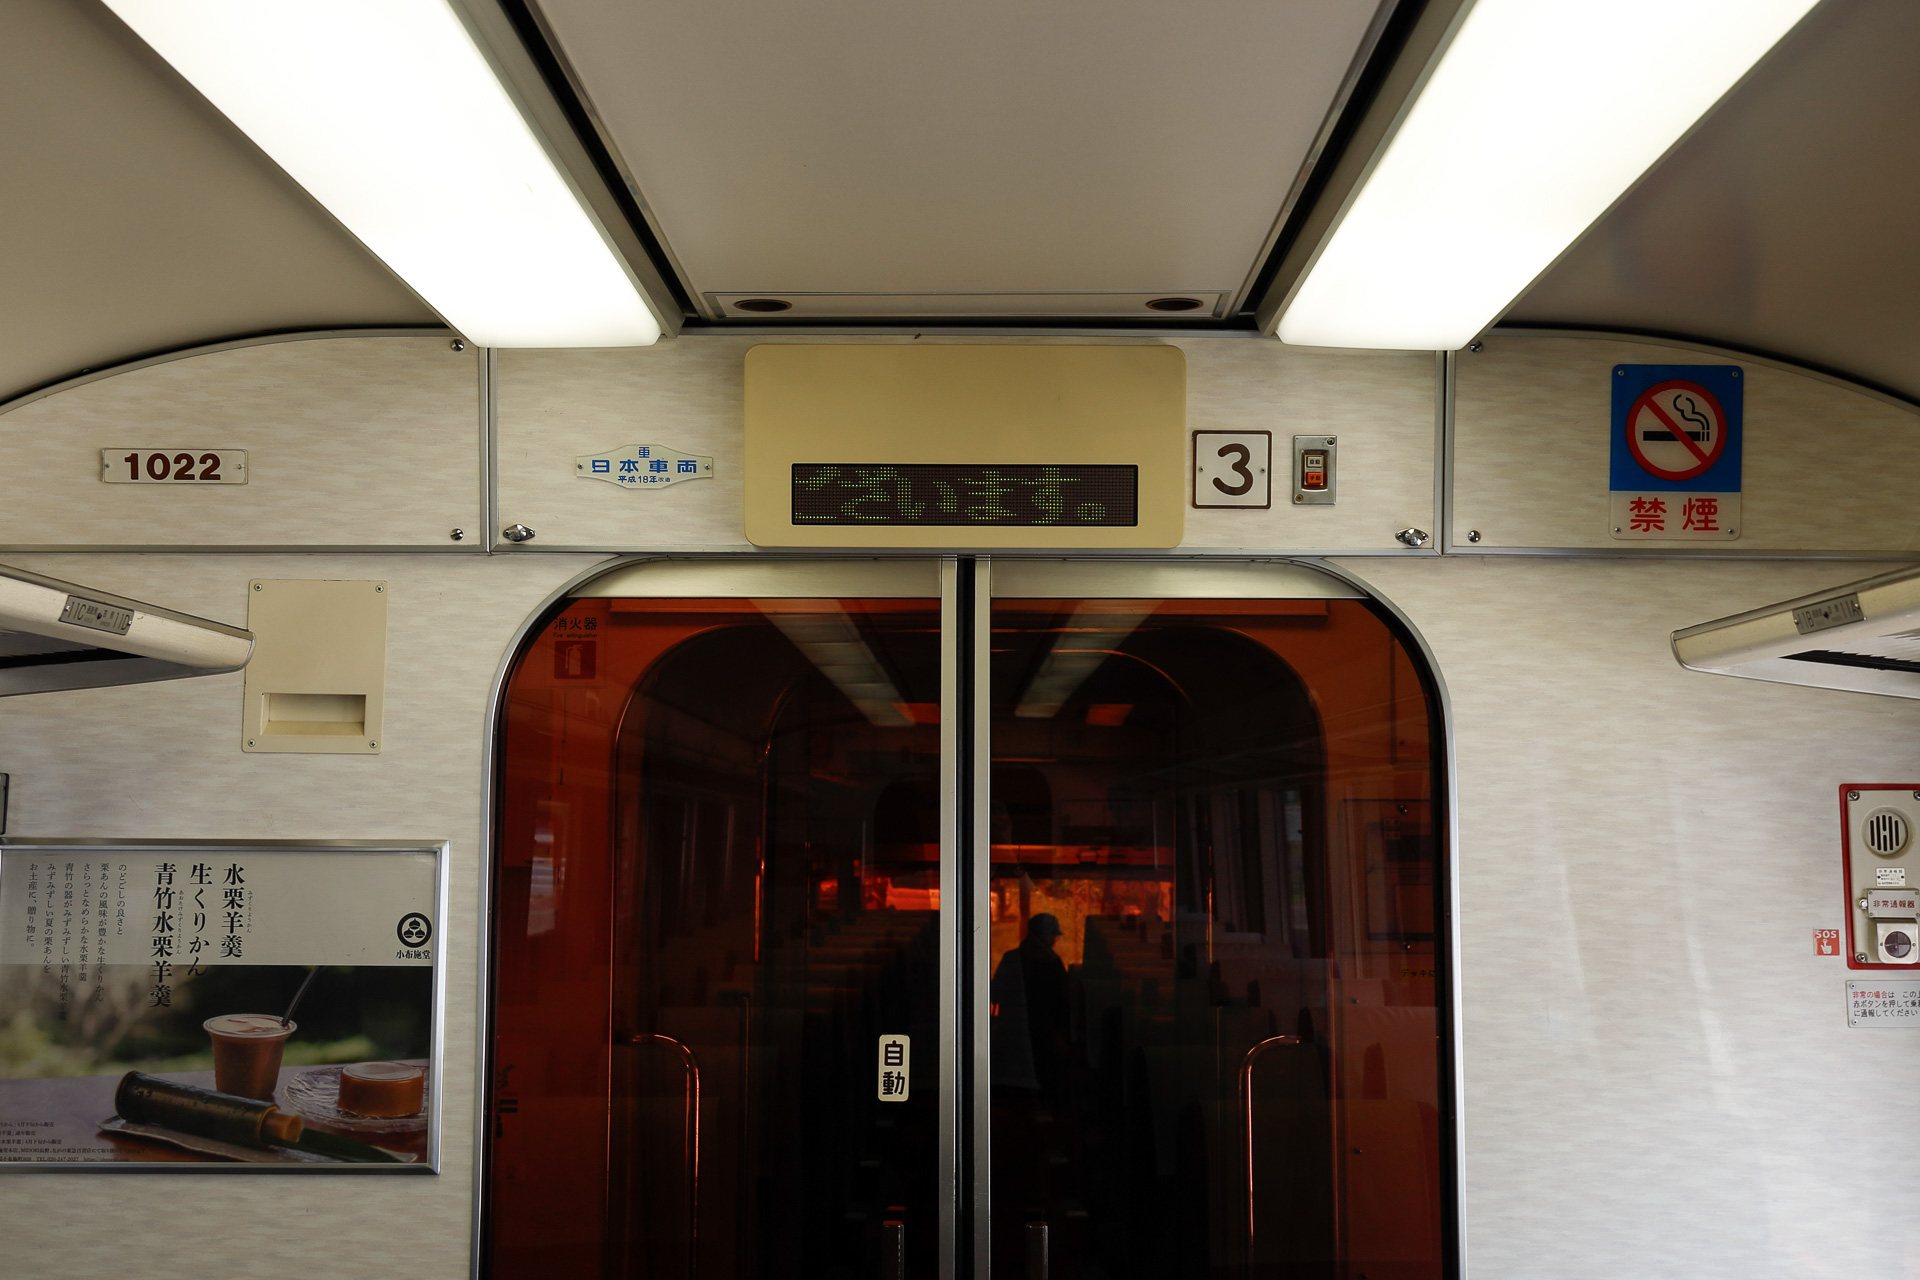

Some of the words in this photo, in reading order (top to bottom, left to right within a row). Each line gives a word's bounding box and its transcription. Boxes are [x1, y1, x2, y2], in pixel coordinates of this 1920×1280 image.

[124, 453, 221, 480] 1022
[591, 459, 697, 473] 日本車両
[1212, 442, 1254, 495] 3
[1629, 496, 1720, 533] 禁煙
[553, 617, 598, 630] 消火器
[116, 863, 127, 936] のどごしの良さと
[219, 863, 246, 958] 水栗羊羹
[1873, 900, 1915, 909] 非常通報器
[148, 862, 178, 1008] 青竹水栗羊羹
[187, 862, 213, 977] 生くりかん
[1815, 930, 1837, 939] SOS
[395, 949, 431, 959] 小布施堂
[882, 1040, 906, 1095] 自動
